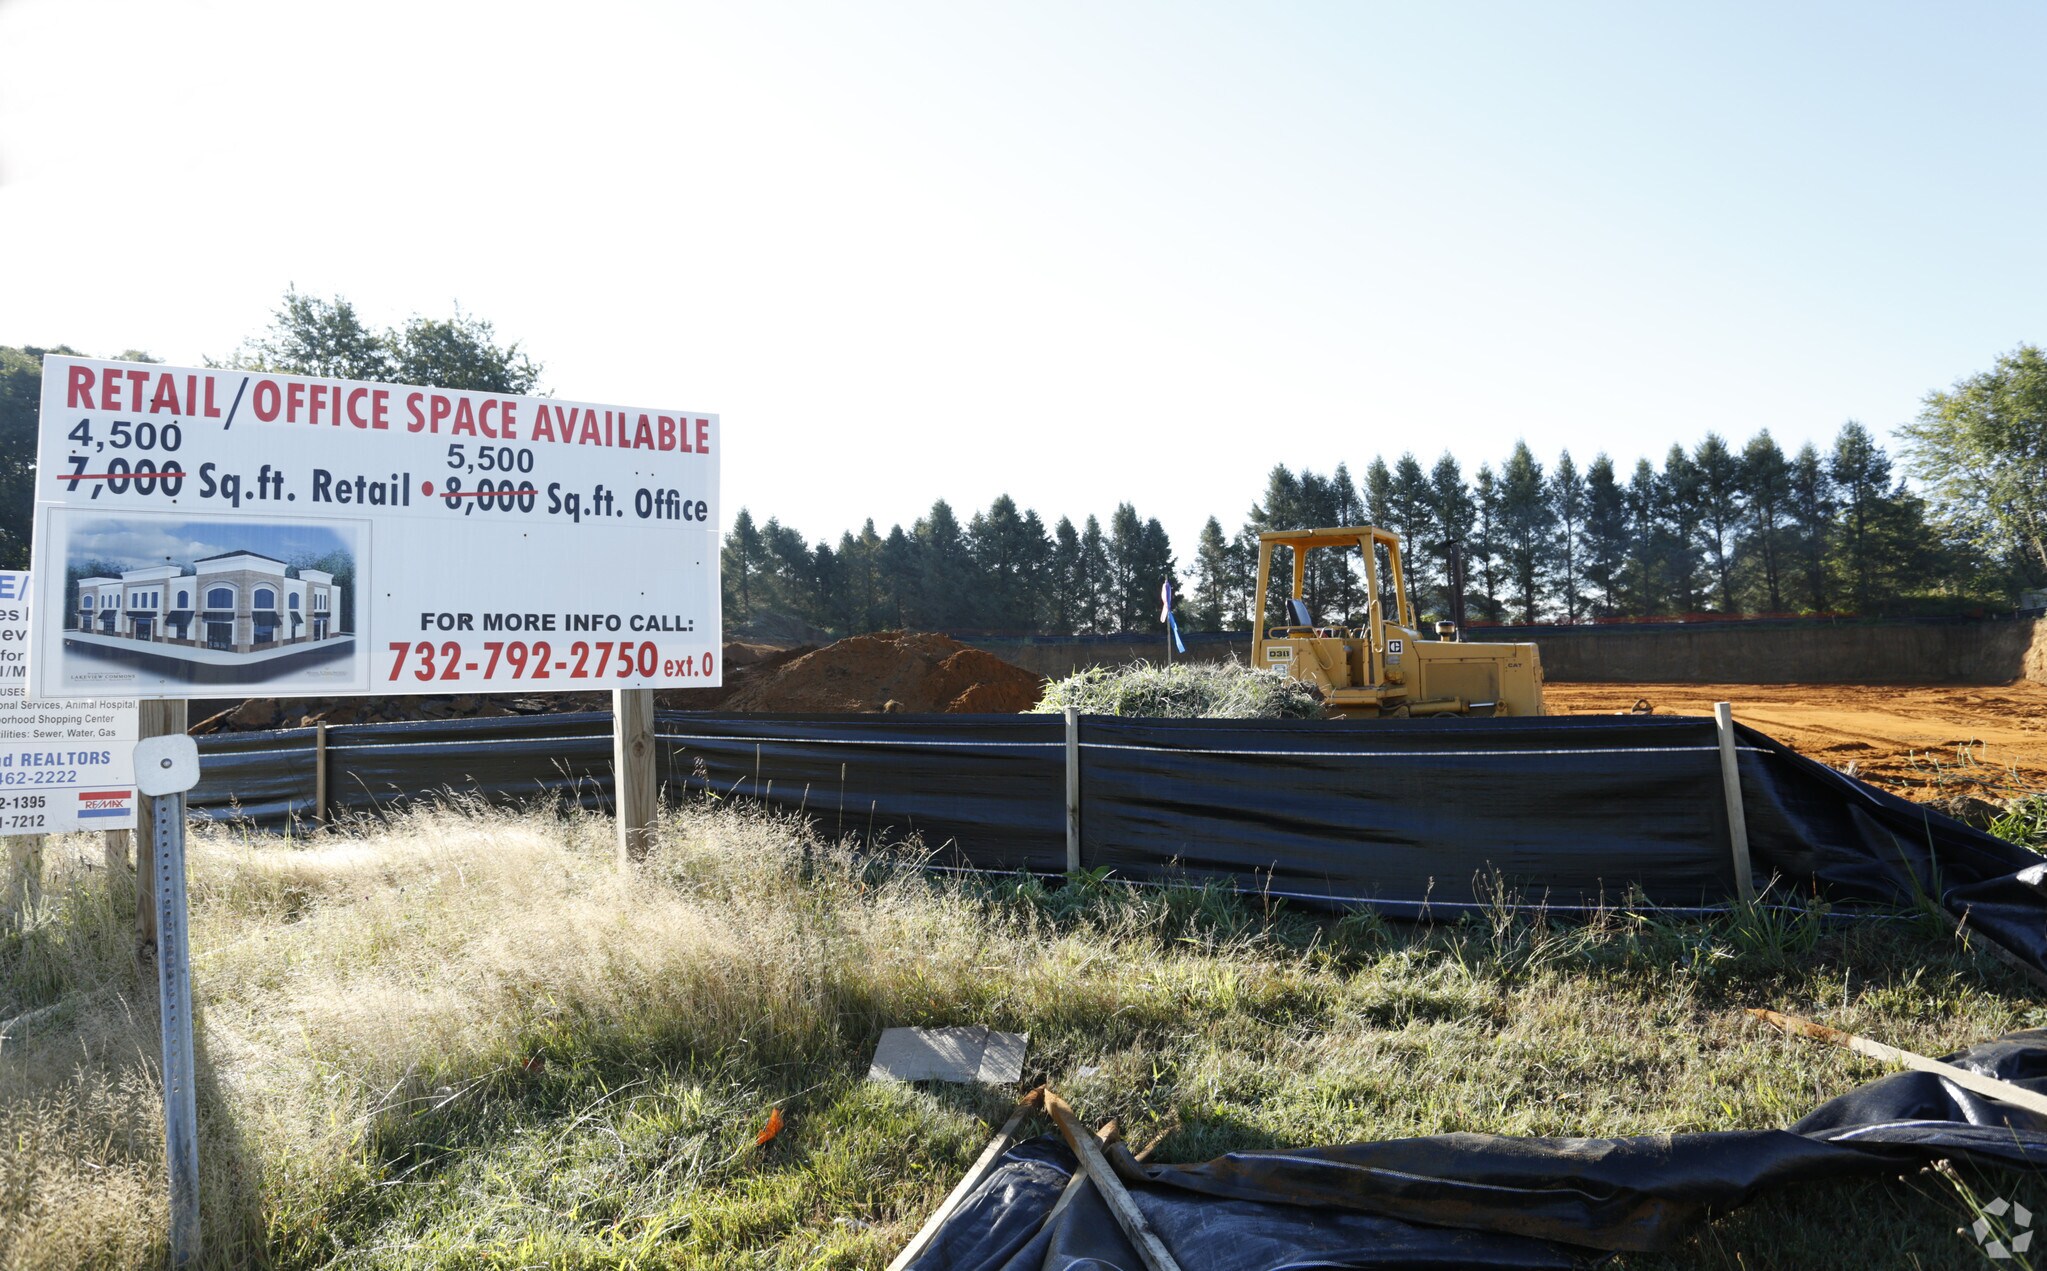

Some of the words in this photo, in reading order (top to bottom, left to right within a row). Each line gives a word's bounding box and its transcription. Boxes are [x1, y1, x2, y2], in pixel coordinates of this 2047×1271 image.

[67, 365, 390, 430] RETAIL/OFFICE
[406, 392, 517, 440] SPACE
[531, 404, 710, 454] AVAILABLE
[68, 418, 182, 453] 4,500
[446, 443, 534, 474] 5,500
[66, 455, 184, 500] 7,000
[199, 462, 296, 508] Sq.ft.
[312, 468, 410, 506] Retail
[444, 476, 536, 516] 8,000
[547, 482, 623, 523] Sq.ft.
[634, 488, 708, 522] Office
[420, 612, 474, 632] FOR
[482, 613, 556, 632] MORE
[564, 614, 622, 632] INFO
[629, 614, 694, 632] CALL:
[387, 641, 659, 682] 732-792-2750
[20, 700, 63, 710] Services,
[65, 700, 97, 710] Animal
[99, 700, 138, 711] Hospital,
[0, 715, 36, 724] orhood
[38, 714, 82, 725] Shopping
[84, 714, 115, 723] Center
[32, 729, 64, 739] Sewer,
[66, 728, 96, 738] Water,
[98, 728, 116, 737] Gas
[20, 751, 111, 767] REALTORS
[85, 799, 124, 809] RE/MAX
